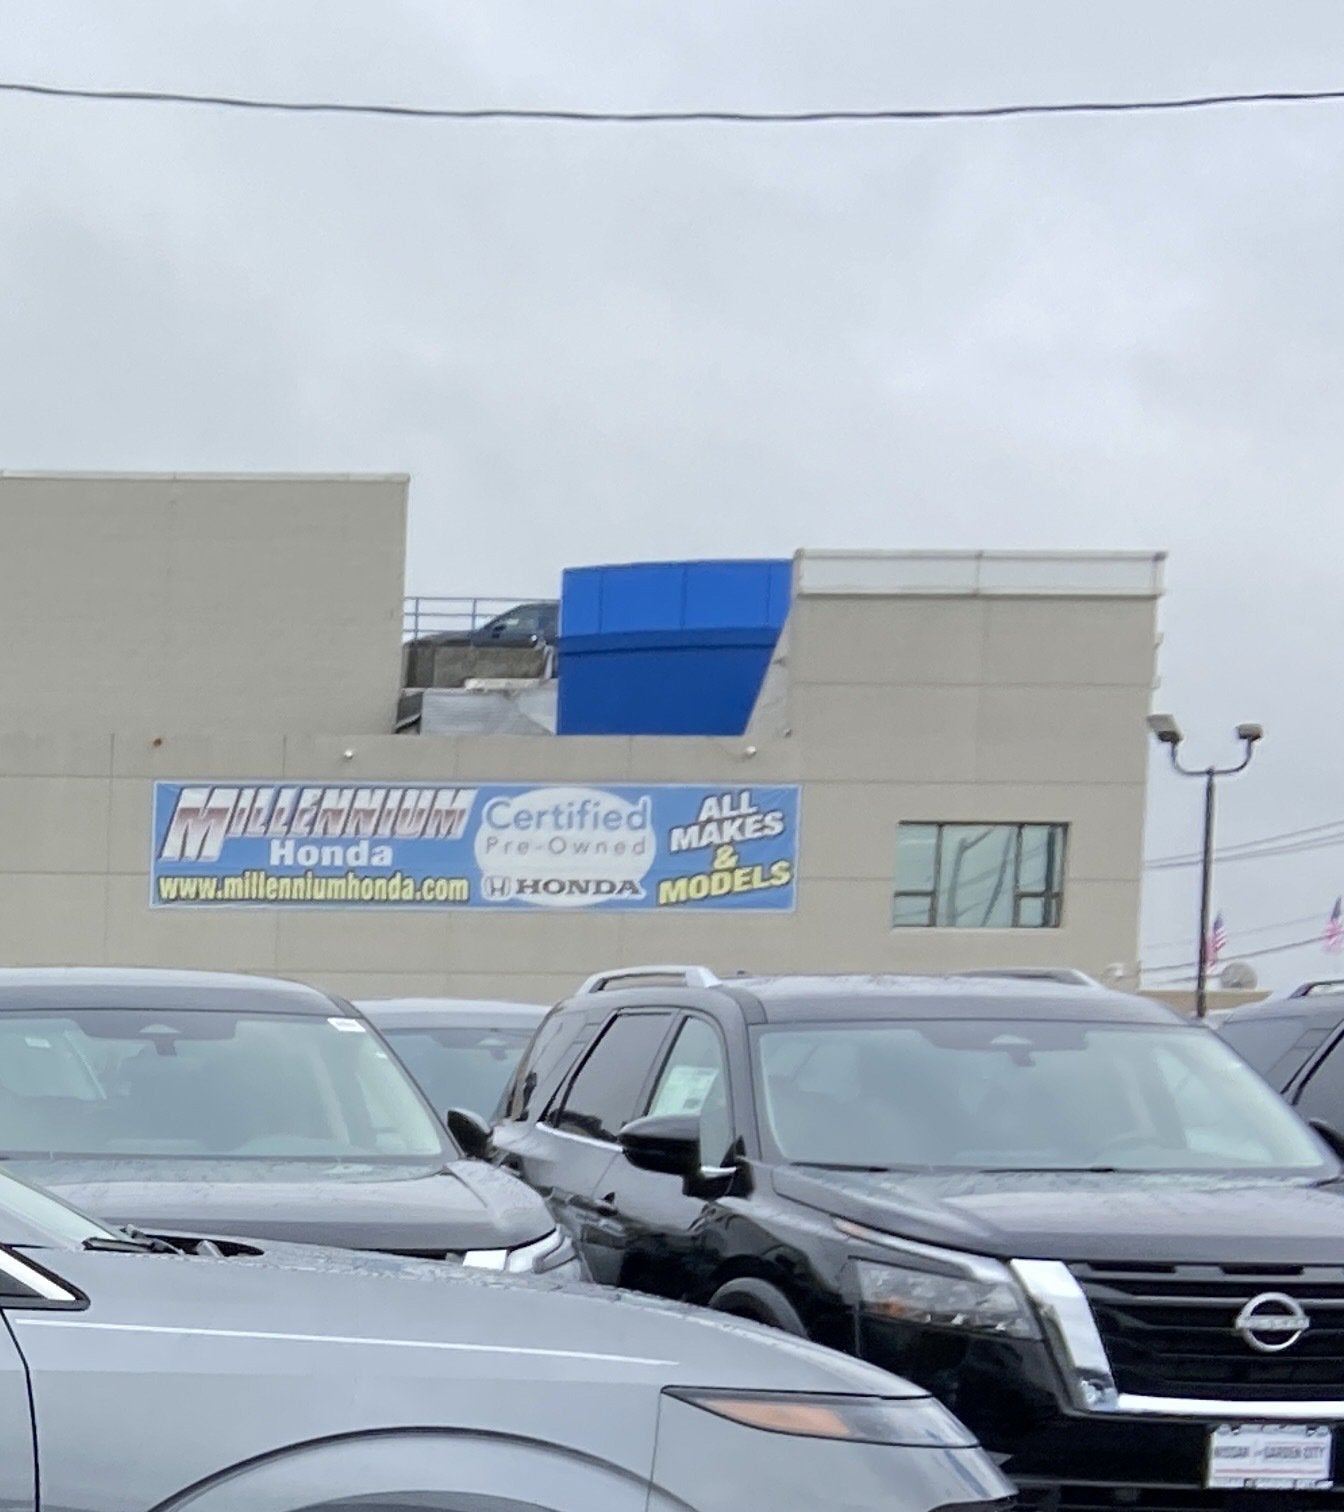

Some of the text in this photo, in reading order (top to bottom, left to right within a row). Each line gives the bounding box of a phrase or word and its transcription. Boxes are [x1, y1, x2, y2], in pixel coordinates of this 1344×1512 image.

[486, 799, 649, 831] Certified
[698, 790, 759, 822] ALL
[158, 787, 479, 862] MILLENNIUM
[669, 811, 785, 852] MAKES
[270, 838, 394, 867] Honda
[486, 836, 647, 855] Pre-Owned
[713, 844, 739, 869] &
[159, 870, 470, 901] www.millenniumhonda.com
[516, 878, 643, 896] HONDA
[659, 860, 792, 905] MODELS
